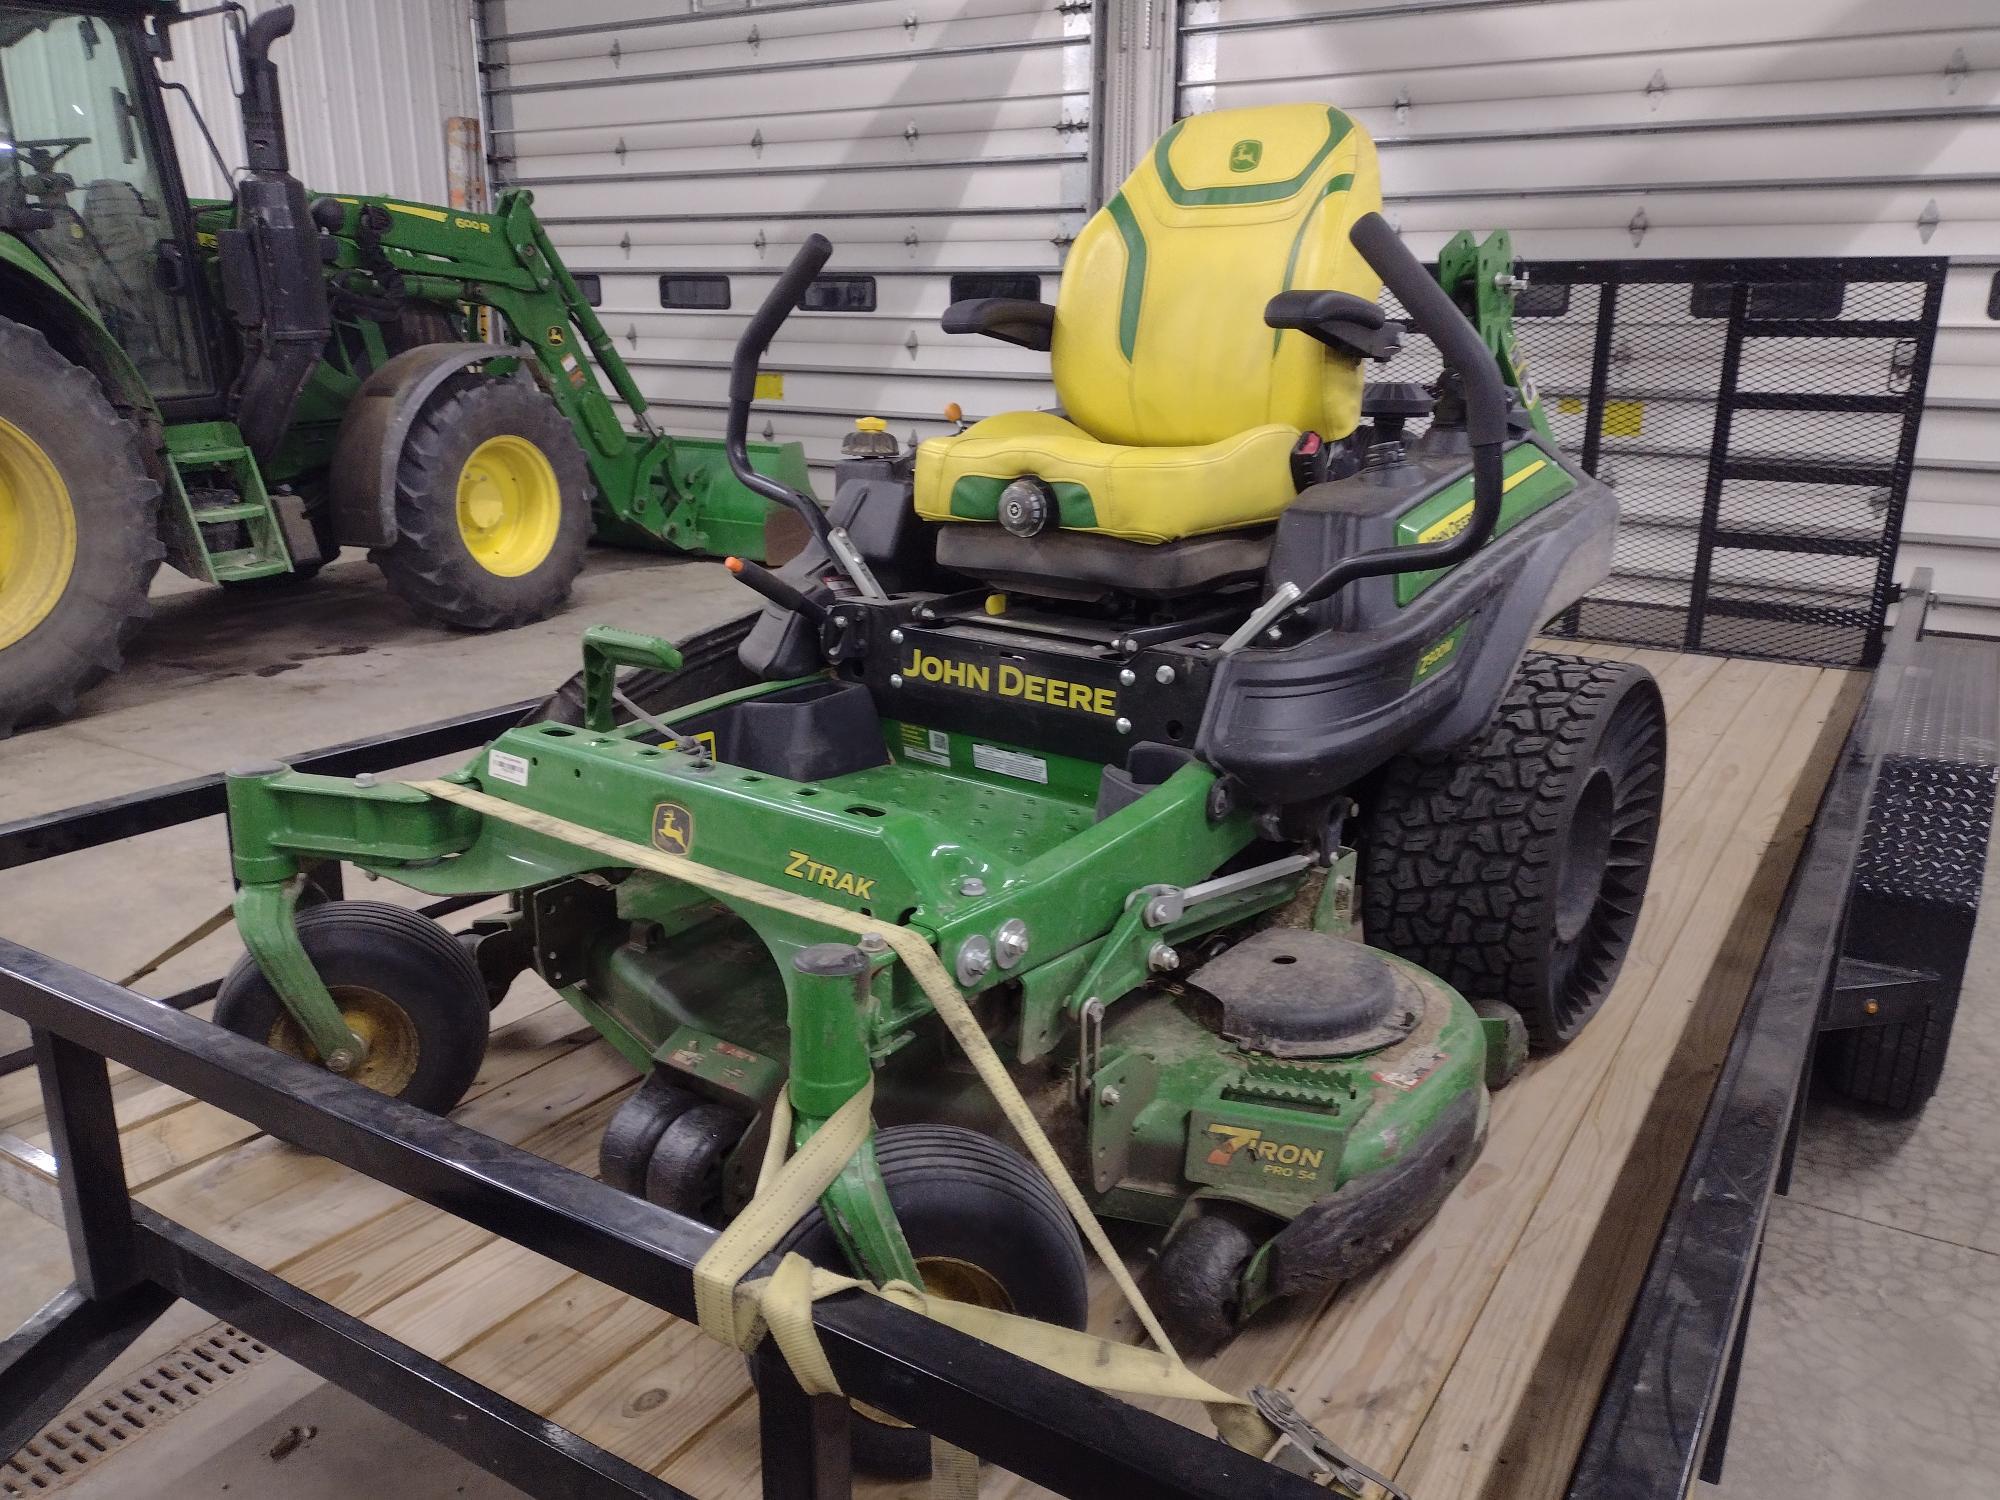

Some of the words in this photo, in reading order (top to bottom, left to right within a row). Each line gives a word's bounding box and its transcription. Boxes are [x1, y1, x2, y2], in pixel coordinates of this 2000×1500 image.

[903, 648, 989, 692] JOHN
[999, 664, 1117, 717] DEERE
[784, 849, 876, 901] ZTRAK
[1263, 1164, 1294, 1177] PRO
